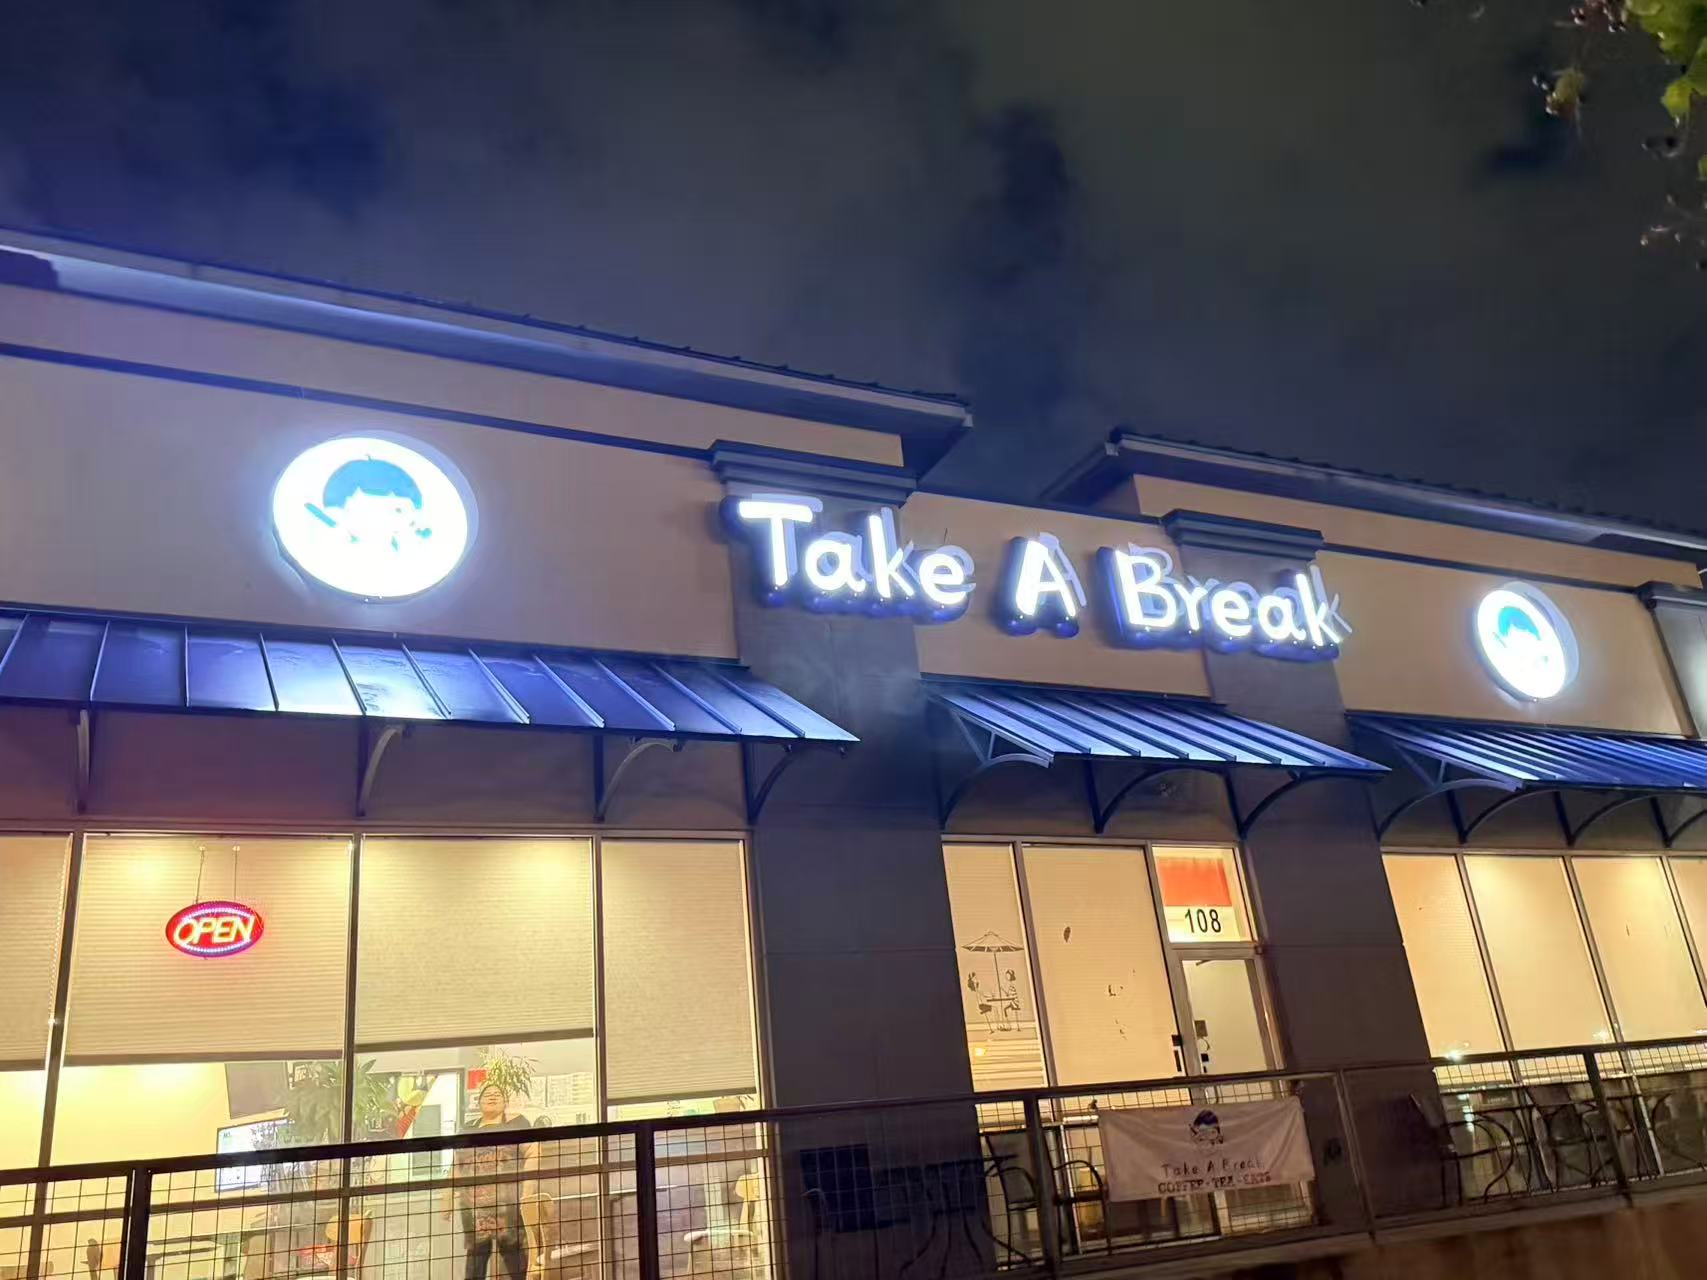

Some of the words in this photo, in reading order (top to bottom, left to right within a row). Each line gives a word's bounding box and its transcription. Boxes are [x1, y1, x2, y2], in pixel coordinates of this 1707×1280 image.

[738, 500, 968, 605] Take
[1014, 539, 1078, 617] A
[1114, 548, 1342, 647] Break
[173, 915, 256, 945] OPEN
[1184, 908, 1222, 934] 108
[1161, 1161, 1198, 1178] Take
[1206, 1160, 1215, 1173] A
